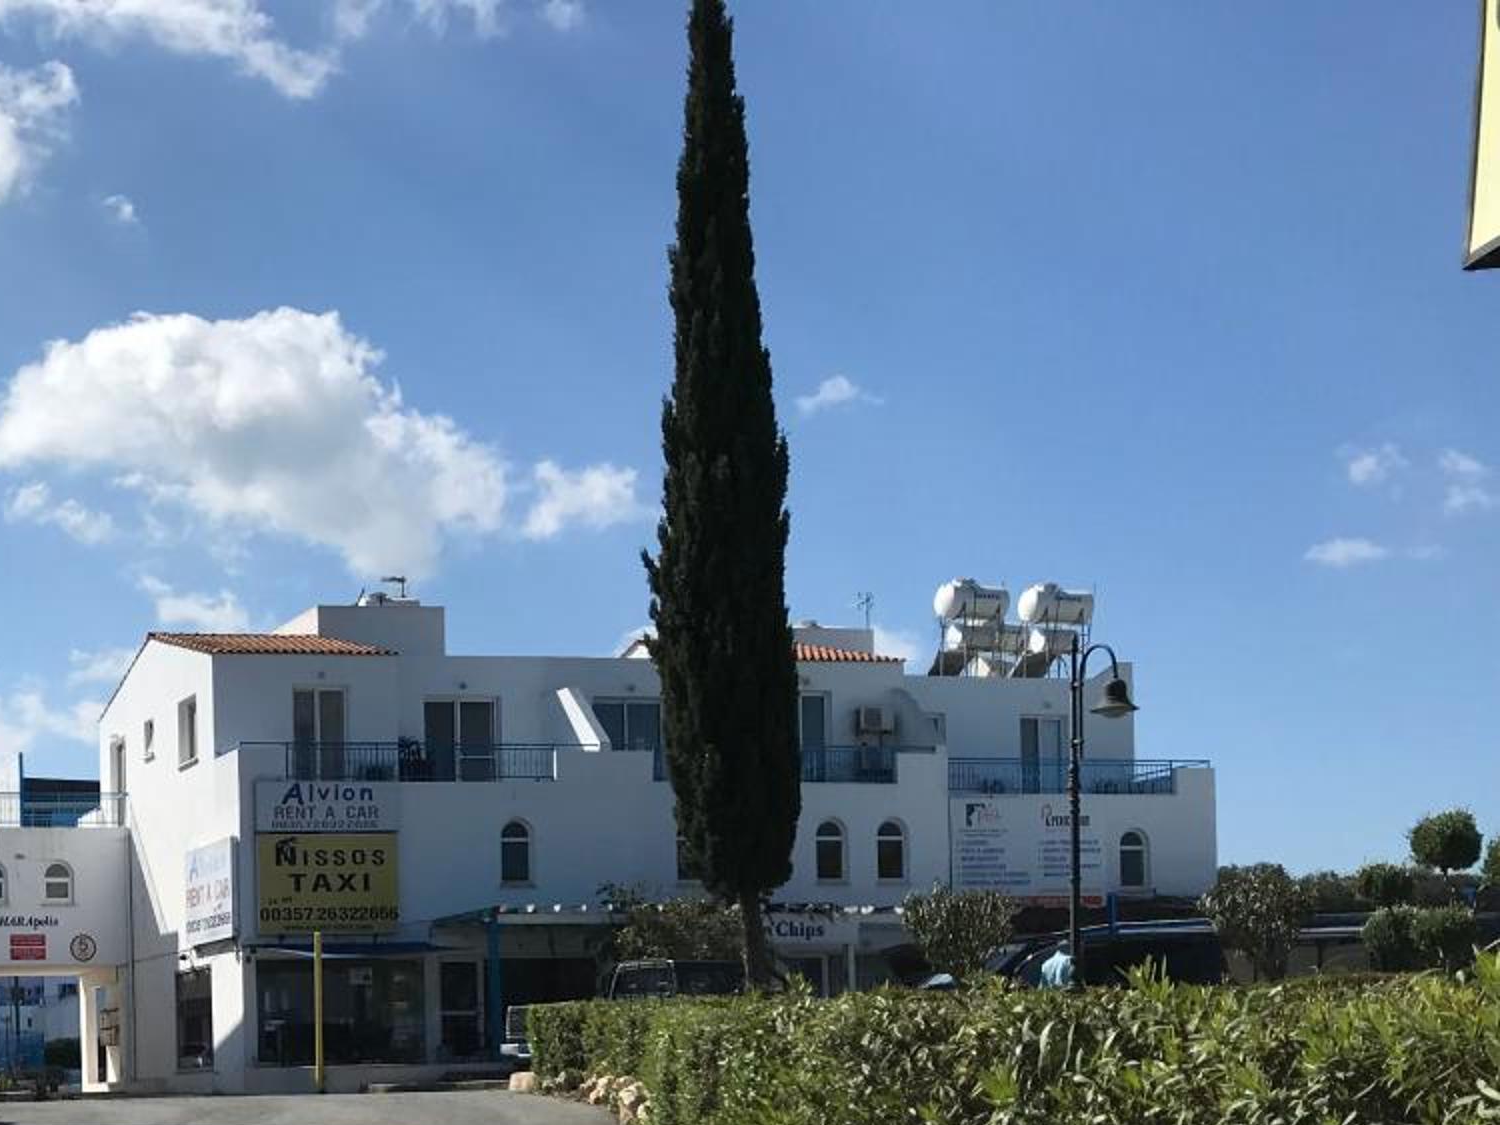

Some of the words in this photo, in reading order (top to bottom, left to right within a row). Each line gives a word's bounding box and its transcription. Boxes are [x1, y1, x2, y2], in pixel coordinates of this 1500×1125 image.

[274, 806, 315, 819] RENT
[325, 806, 335, 818] A
[346, 806, 378, 819] CAR
[288, 873, 370, 892] TAXI
